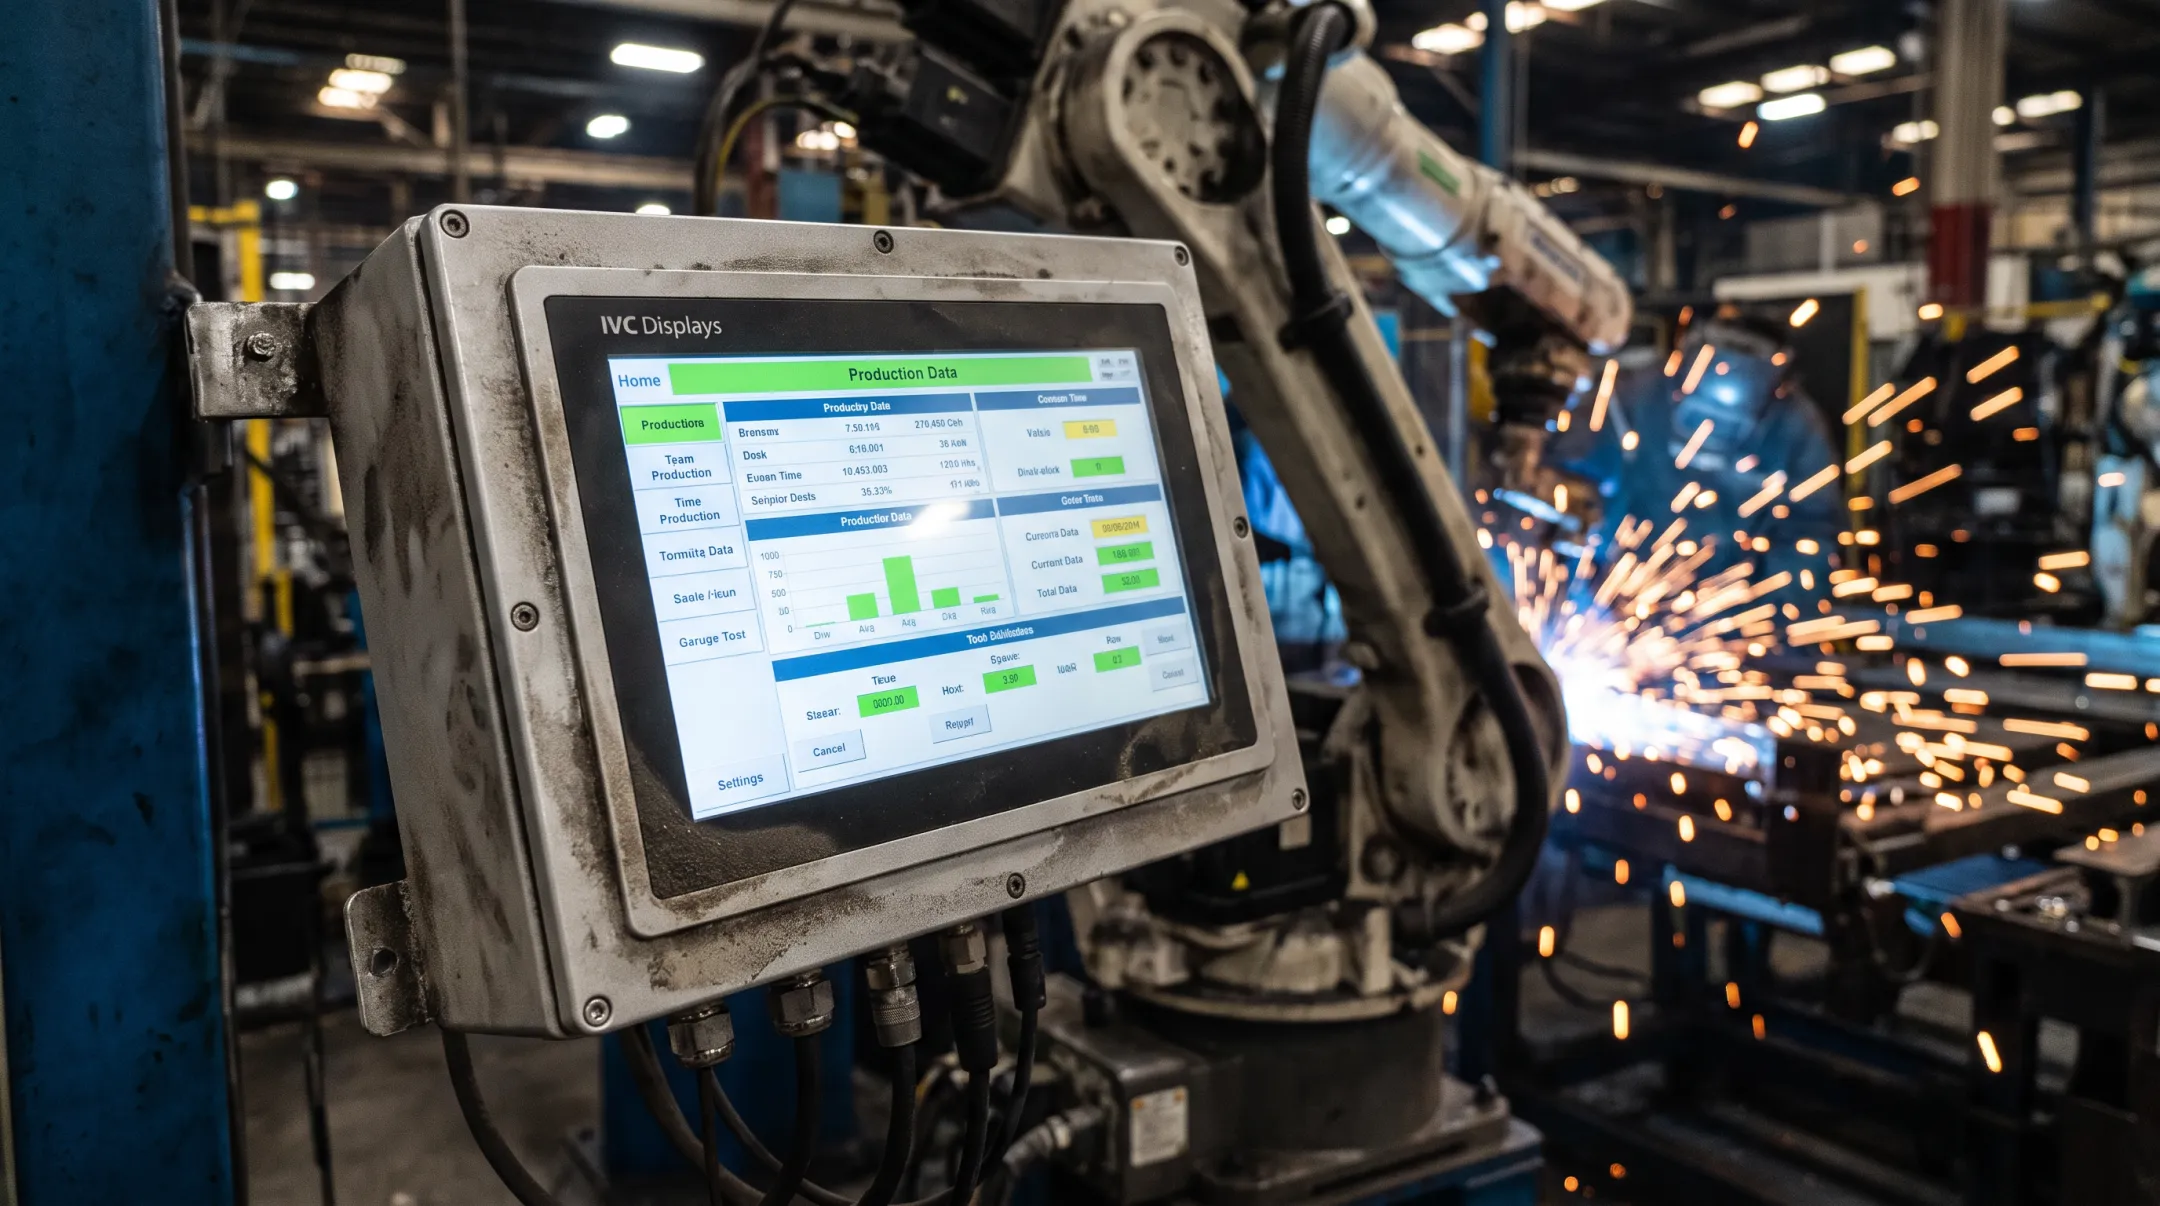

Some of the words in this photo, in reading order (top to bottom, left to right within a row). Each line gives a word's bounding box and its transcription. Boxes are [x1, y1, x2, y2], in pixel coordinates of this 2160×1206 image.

[600, 316, 638, 335] IVC
[642, 315, 723, 339] Displays
[848, 366, 924, 381] Production
[927, 365, 958, 379] Data
[618, 374, 661, 388] Home
[664, 454, 695, 466] Team
[742, 450, 768, 460] Dosk
[651, 468, 712, 481] Production
[778, 470, 803, 481] Time
[861, 486, 893, 496] 35.33%
[674, 497, 702, 508] Time
[659, 510, 721, 524] Production
[890, 511, 913, 522] Data
[1060, 527, 1080, 538] Data
[708, 545, 734, 556] Data
[760, 550, 780, 561] 1000
[1064, 554, 1084, 565] Data
[768, 568, 783, 580] 750
[771, 587, 787, 599] 500
[1036, 587, 1058, 598] Total
[1058, 584, 1078, 595] Data
[787, 624, 793, 634] 0
[679, 635, 719, 648] Garuge
[721, 630, 747, 641] Tost
[812, 742, 846, 757] Cancel
[717, 772, 764, 791] Settings
